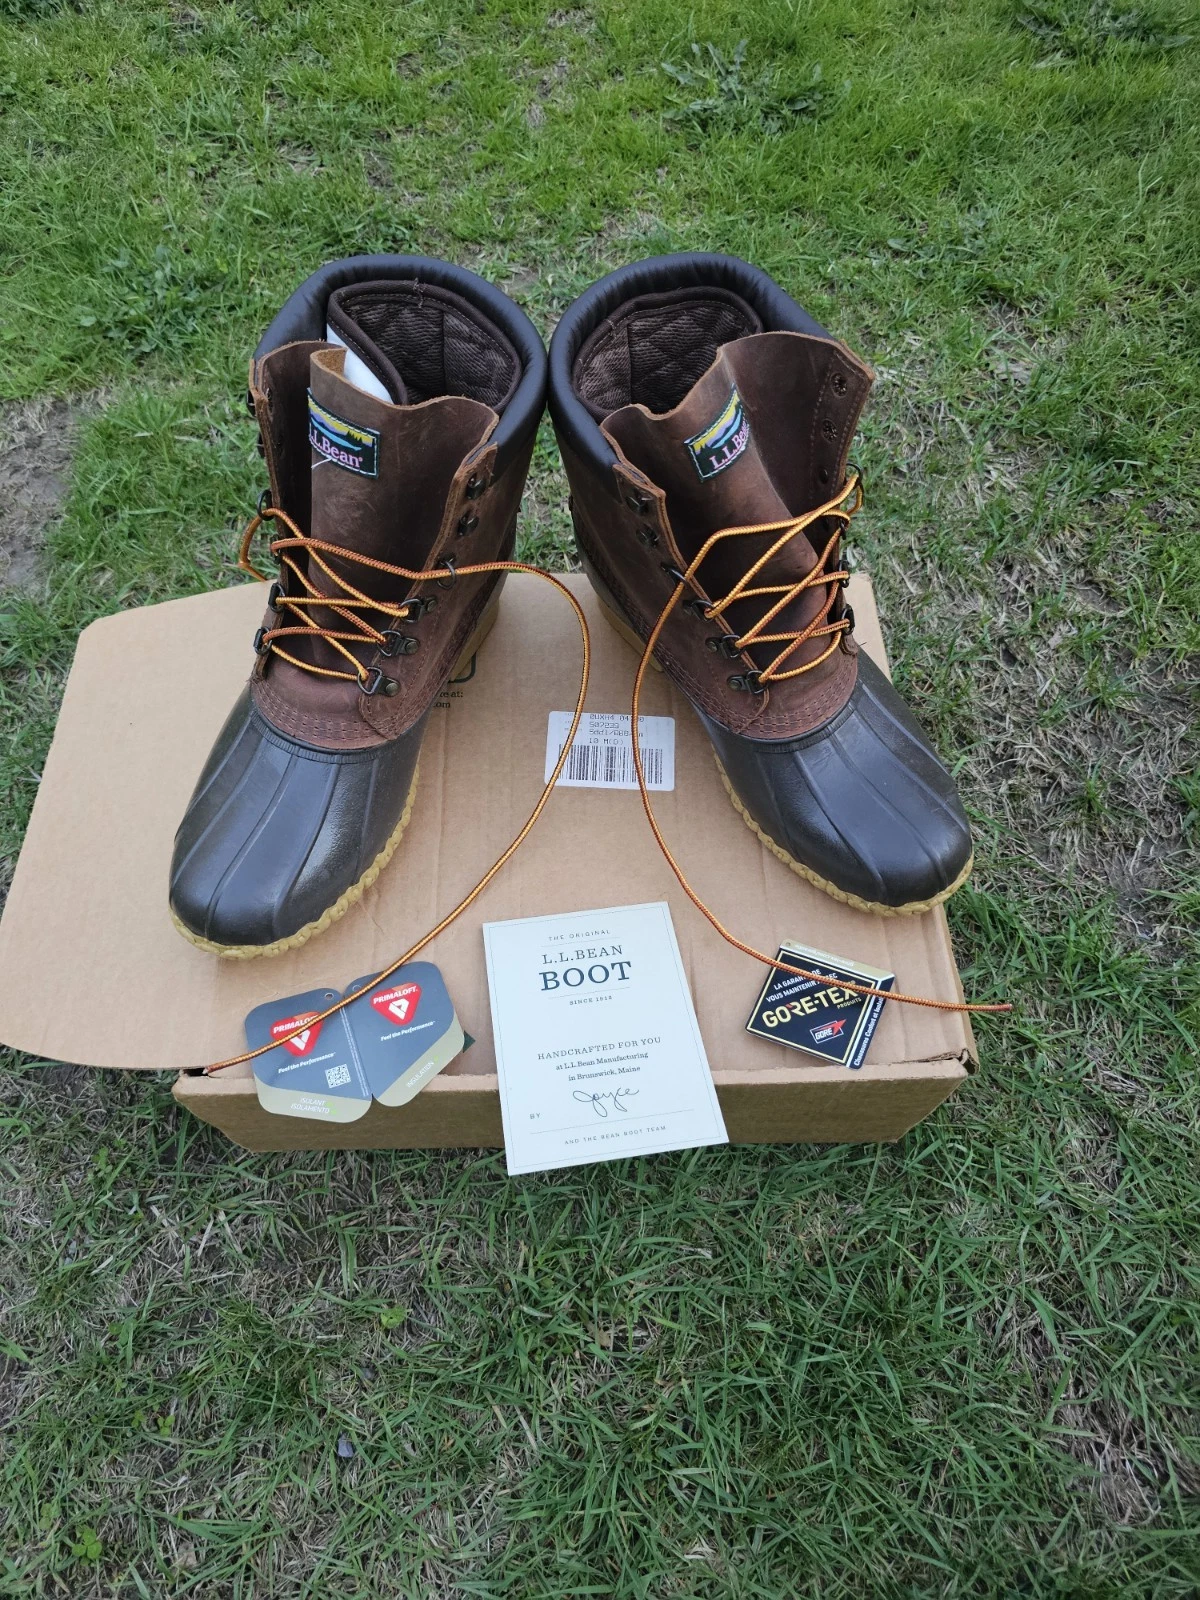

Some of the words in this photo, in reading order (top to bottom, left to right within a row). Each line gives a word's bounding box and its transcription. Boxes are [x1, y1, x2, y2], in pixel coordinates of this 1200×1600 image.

[569, 929, 611, 939] ORIGINAL
[542, 945, 623, 965] L.L.BEAN
[539, 961, 632, 991] BOOT
[373, 986, 417, 1005] PRIMALOFT
[766, 994, 784, 1003] VOUS
[783, 980, 817, 997] MAINTENIR
[773, 983, 783, 991] LA
[569, 997, 593, 1006] SINCE
[762, 985, 859, 1028] GORE-TEX
[837, 997, 862, 1009] PRODUITS
[273, 1014, 320, 1034] PRIMALO
[380, 1033, 391, 1041] Feel
[401, 1021, 434, 1035] Performance
[814, 1027, 833, 1041] GORE
[537, 1043, 615, 1060] HANDCRAFTED
[618, 1040, 638, 1049] FOR
[641, 1036, 661, 1046] YOU
[278, 1065, 290, 1074] Feel
[300, 1053, 335, 1067] Performance
[555, 1063, 563, 1071] at
[596, 1052, 649, 1065] Manufacturing
[406, 1060, 435, 1088] INSULATION
[577, 1069, 617, 1080] Brunswick,
[618, 1066, 641, 1075] Maine
[572, 1087, 639, 1118] Joyce
[646, 1125, 666, 1133] TEAM
